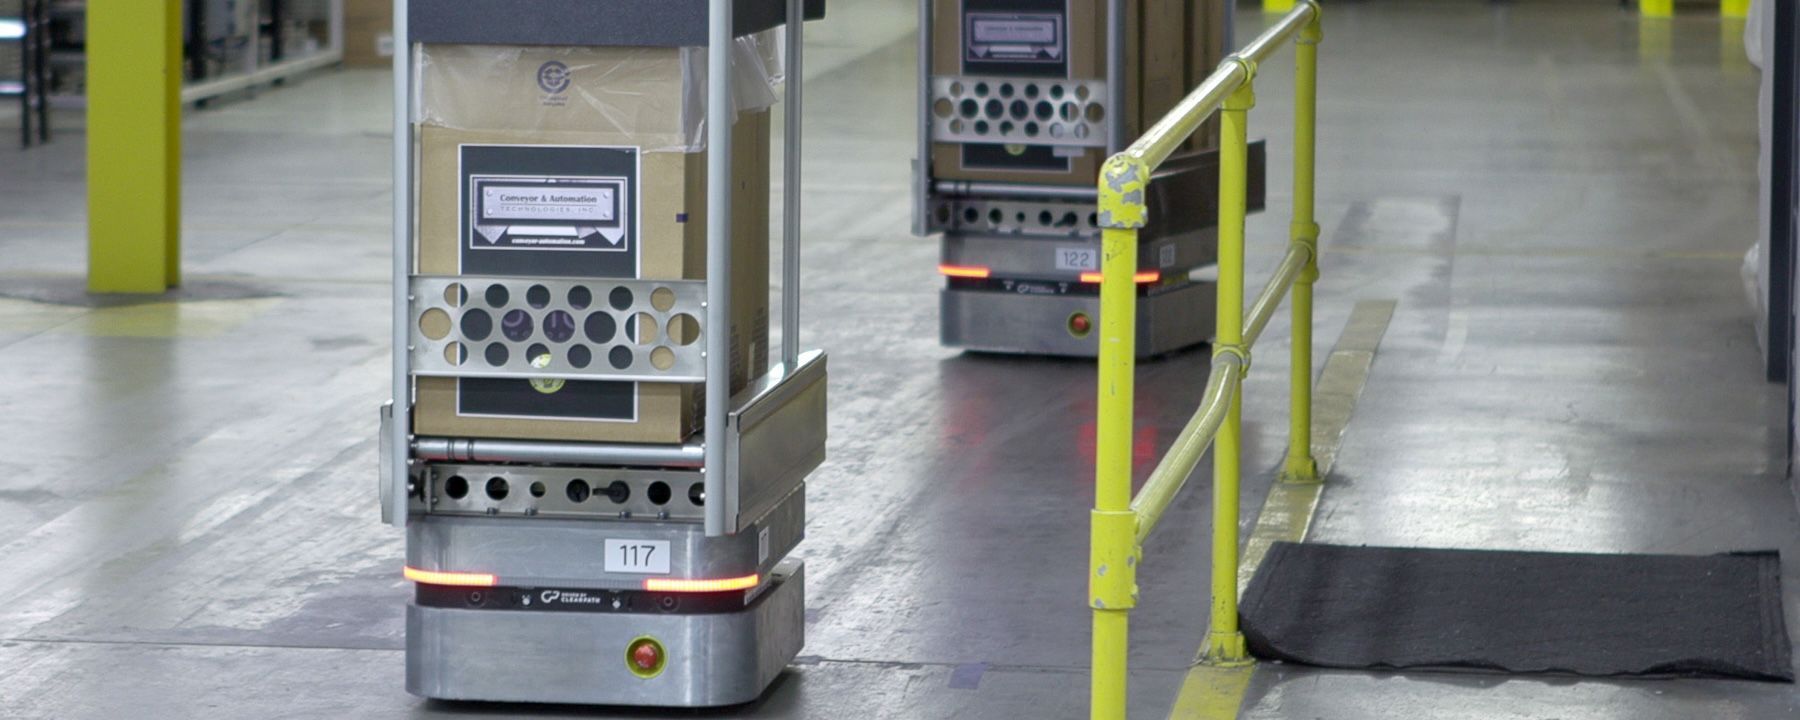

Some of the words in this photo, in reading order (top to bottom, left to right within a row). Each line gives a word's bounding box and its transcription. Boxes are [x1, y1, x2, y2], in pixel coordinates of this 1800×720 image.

[500, 194, 538, 204] Conveyor
[549, 195, 598, 204] Automation
[1063, 252, 1089, 267] 122
[619, 545, 656, 567] 117
